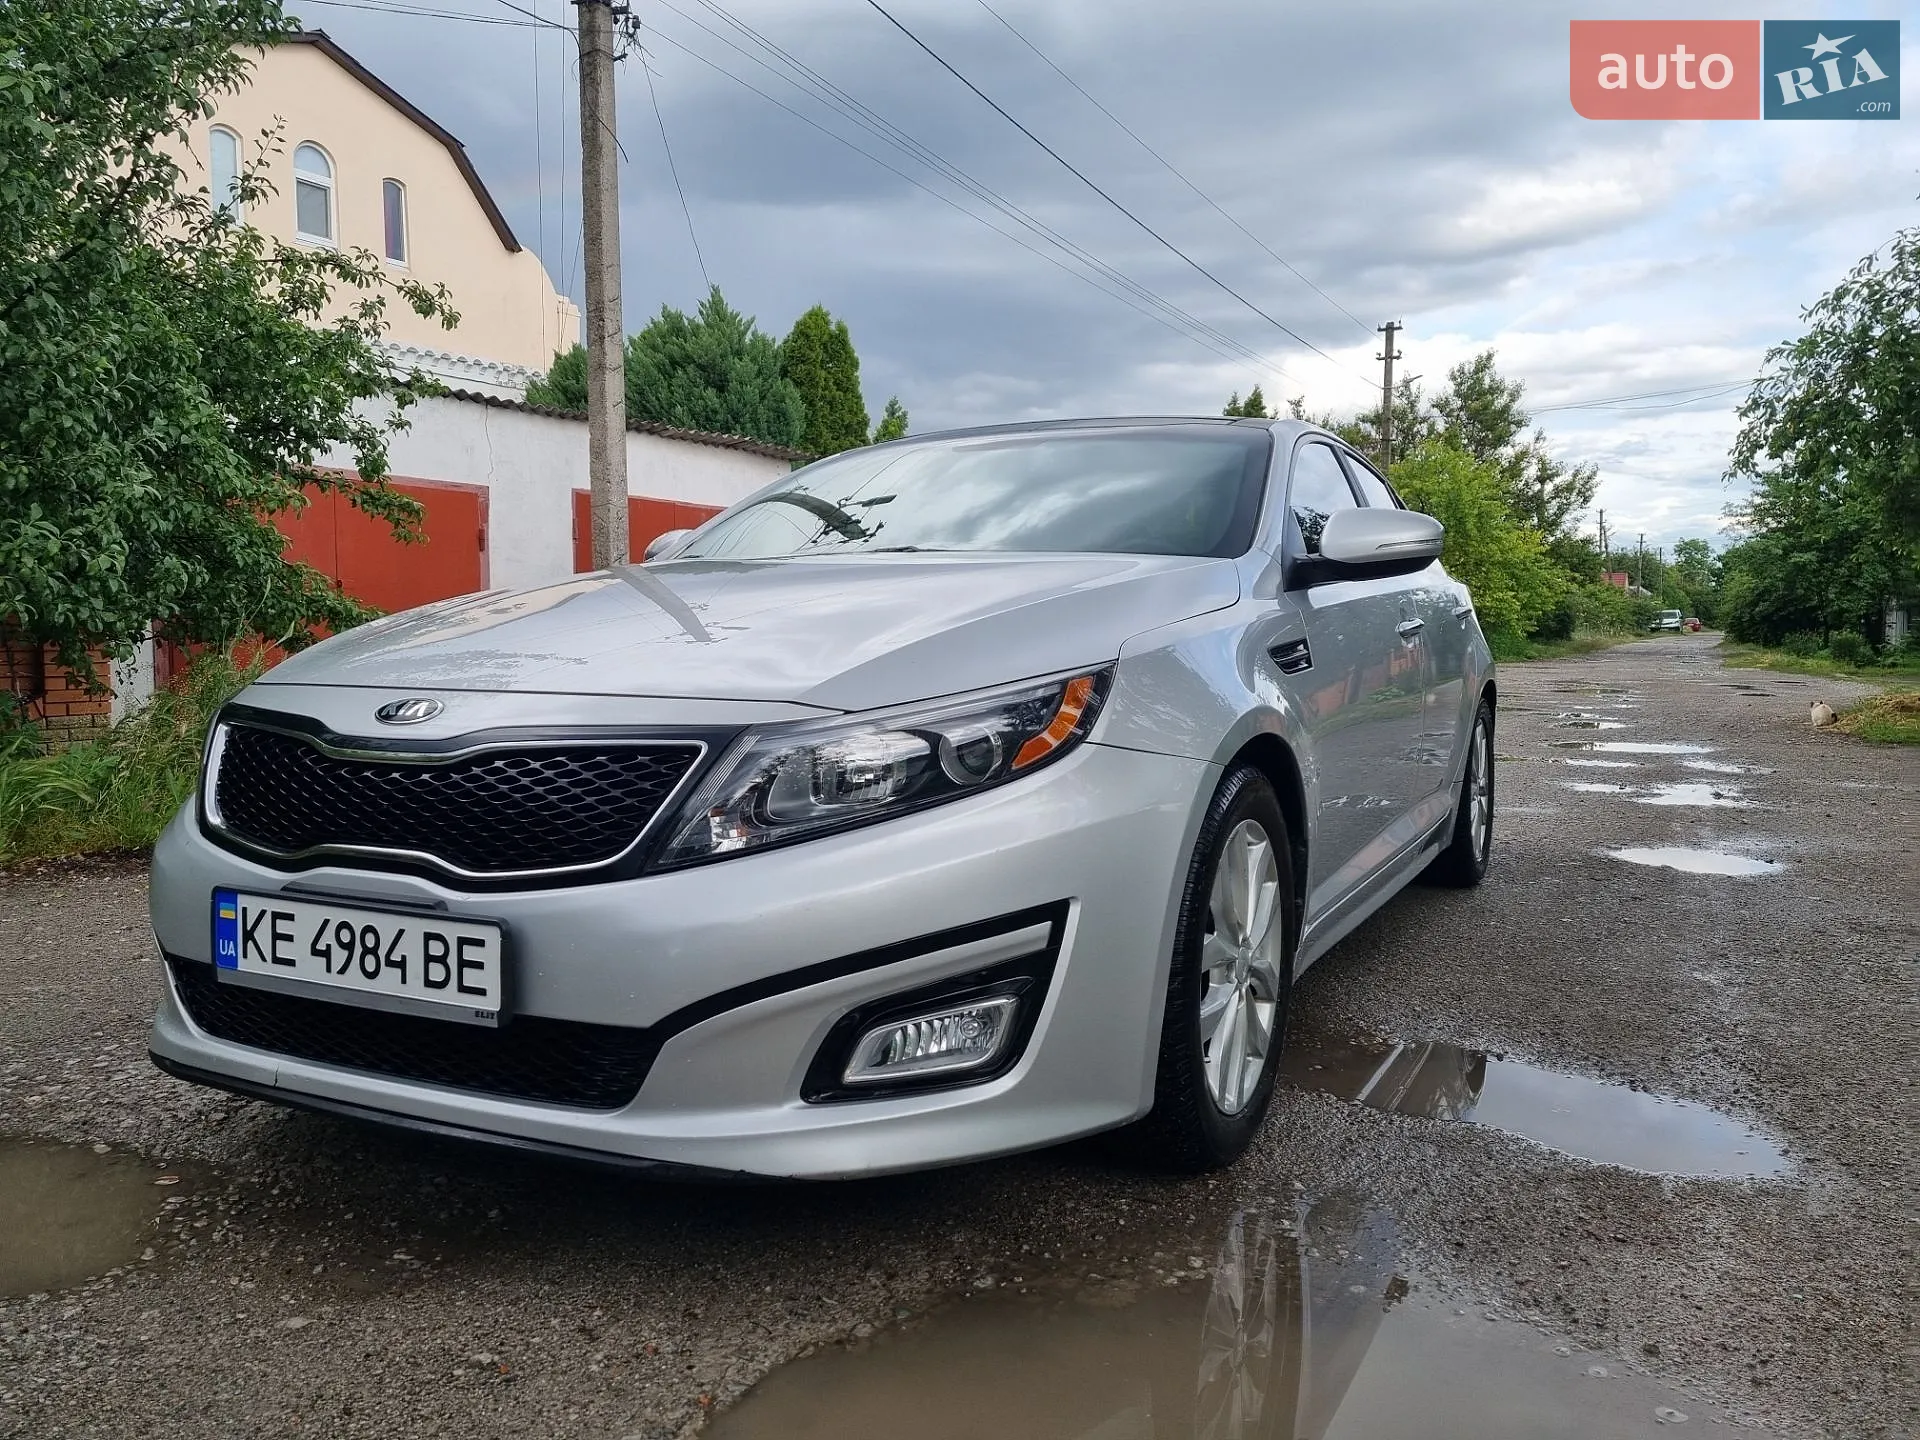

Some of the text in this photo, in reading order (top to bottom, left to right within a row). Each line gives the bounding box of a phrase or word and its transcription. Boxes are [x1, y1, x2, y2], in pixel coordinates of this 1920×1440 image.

[219, 939, 236, 957] UA
[241, 906, 487, 996] KE 4984 BE
